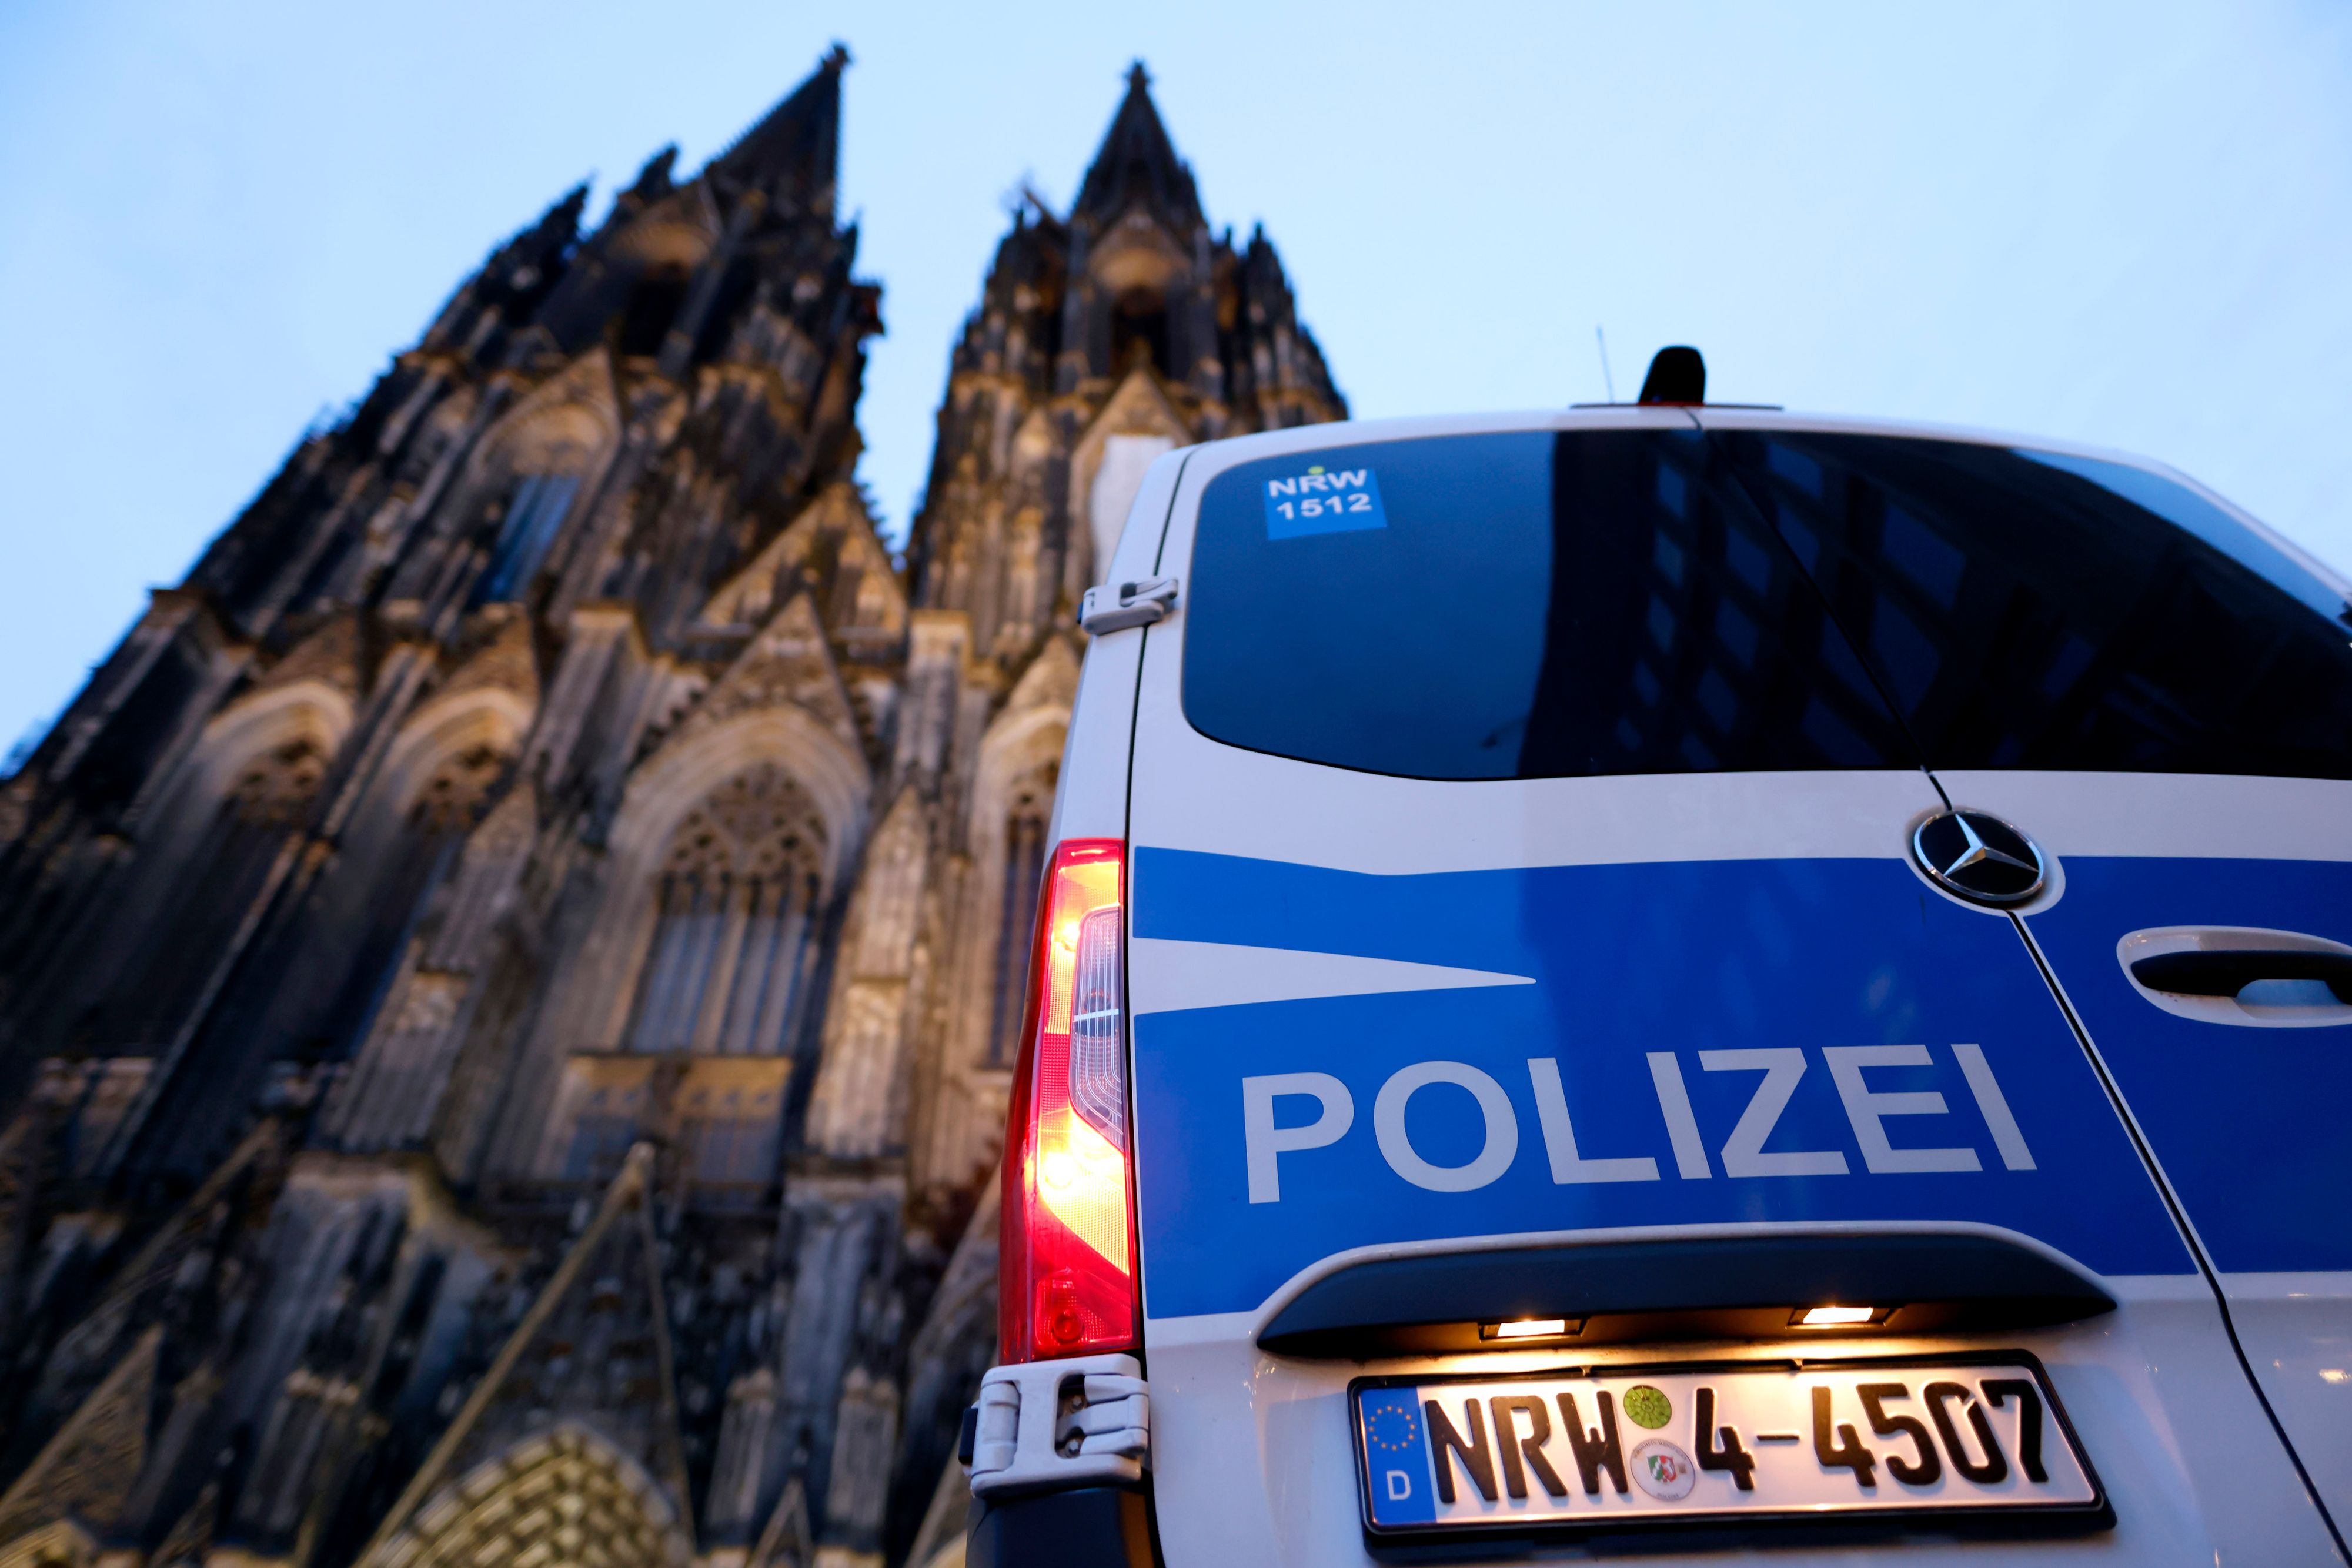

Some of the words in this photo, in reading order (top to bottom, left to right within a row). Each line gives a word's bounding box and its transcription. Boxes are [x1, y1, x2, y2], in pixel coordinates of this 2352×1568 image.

[1268, 469, 1368, 497] NRW
[1276, 493, 1372, 520] 1512
[1242, 1043, 2038, 1204] POLIZEI
[1425, 1390, 1629, 1503] NRW
[1695, 1379, 2049, 1491] 4-4507
[1386, 1470, 1411, 1501] D
